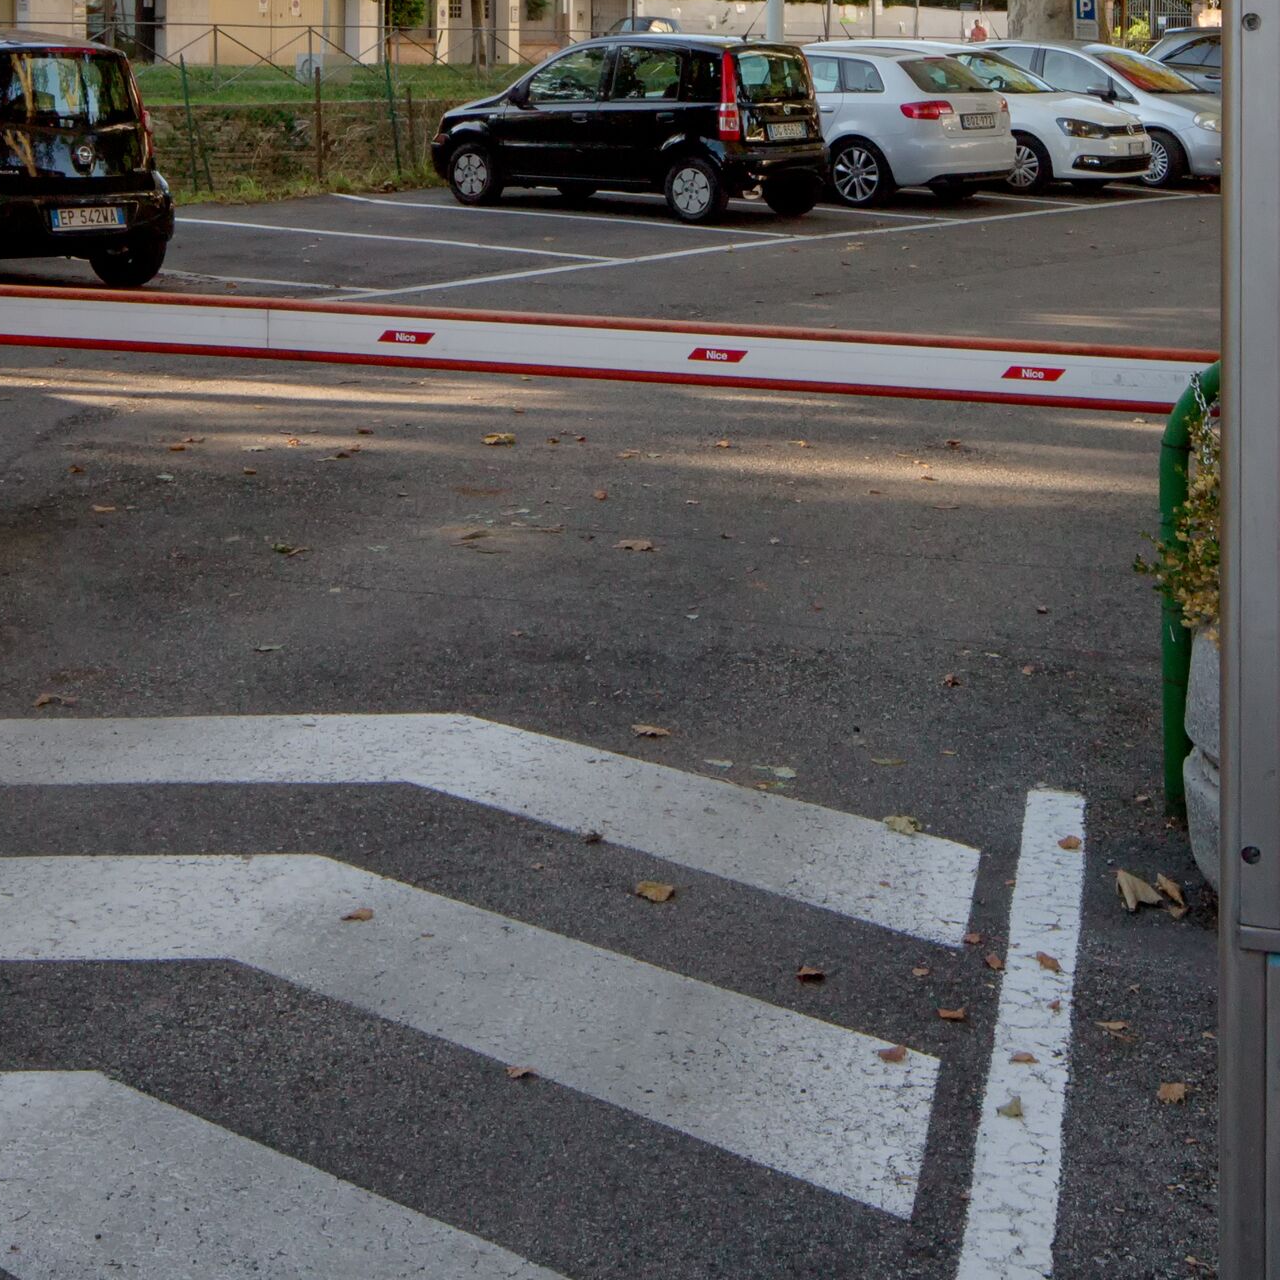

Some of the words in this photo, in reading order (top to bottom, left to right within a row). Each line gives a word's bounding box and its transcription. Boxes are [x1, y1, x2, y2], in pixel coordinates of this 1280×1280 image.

[60, 210, 74, 225] EP
[80, 208, 118, 224] 542WA
[395, 332, 416, 342] Nice
[706, 350, 728, 360] Nice
[1021, 368, 1045, 379] Nice
